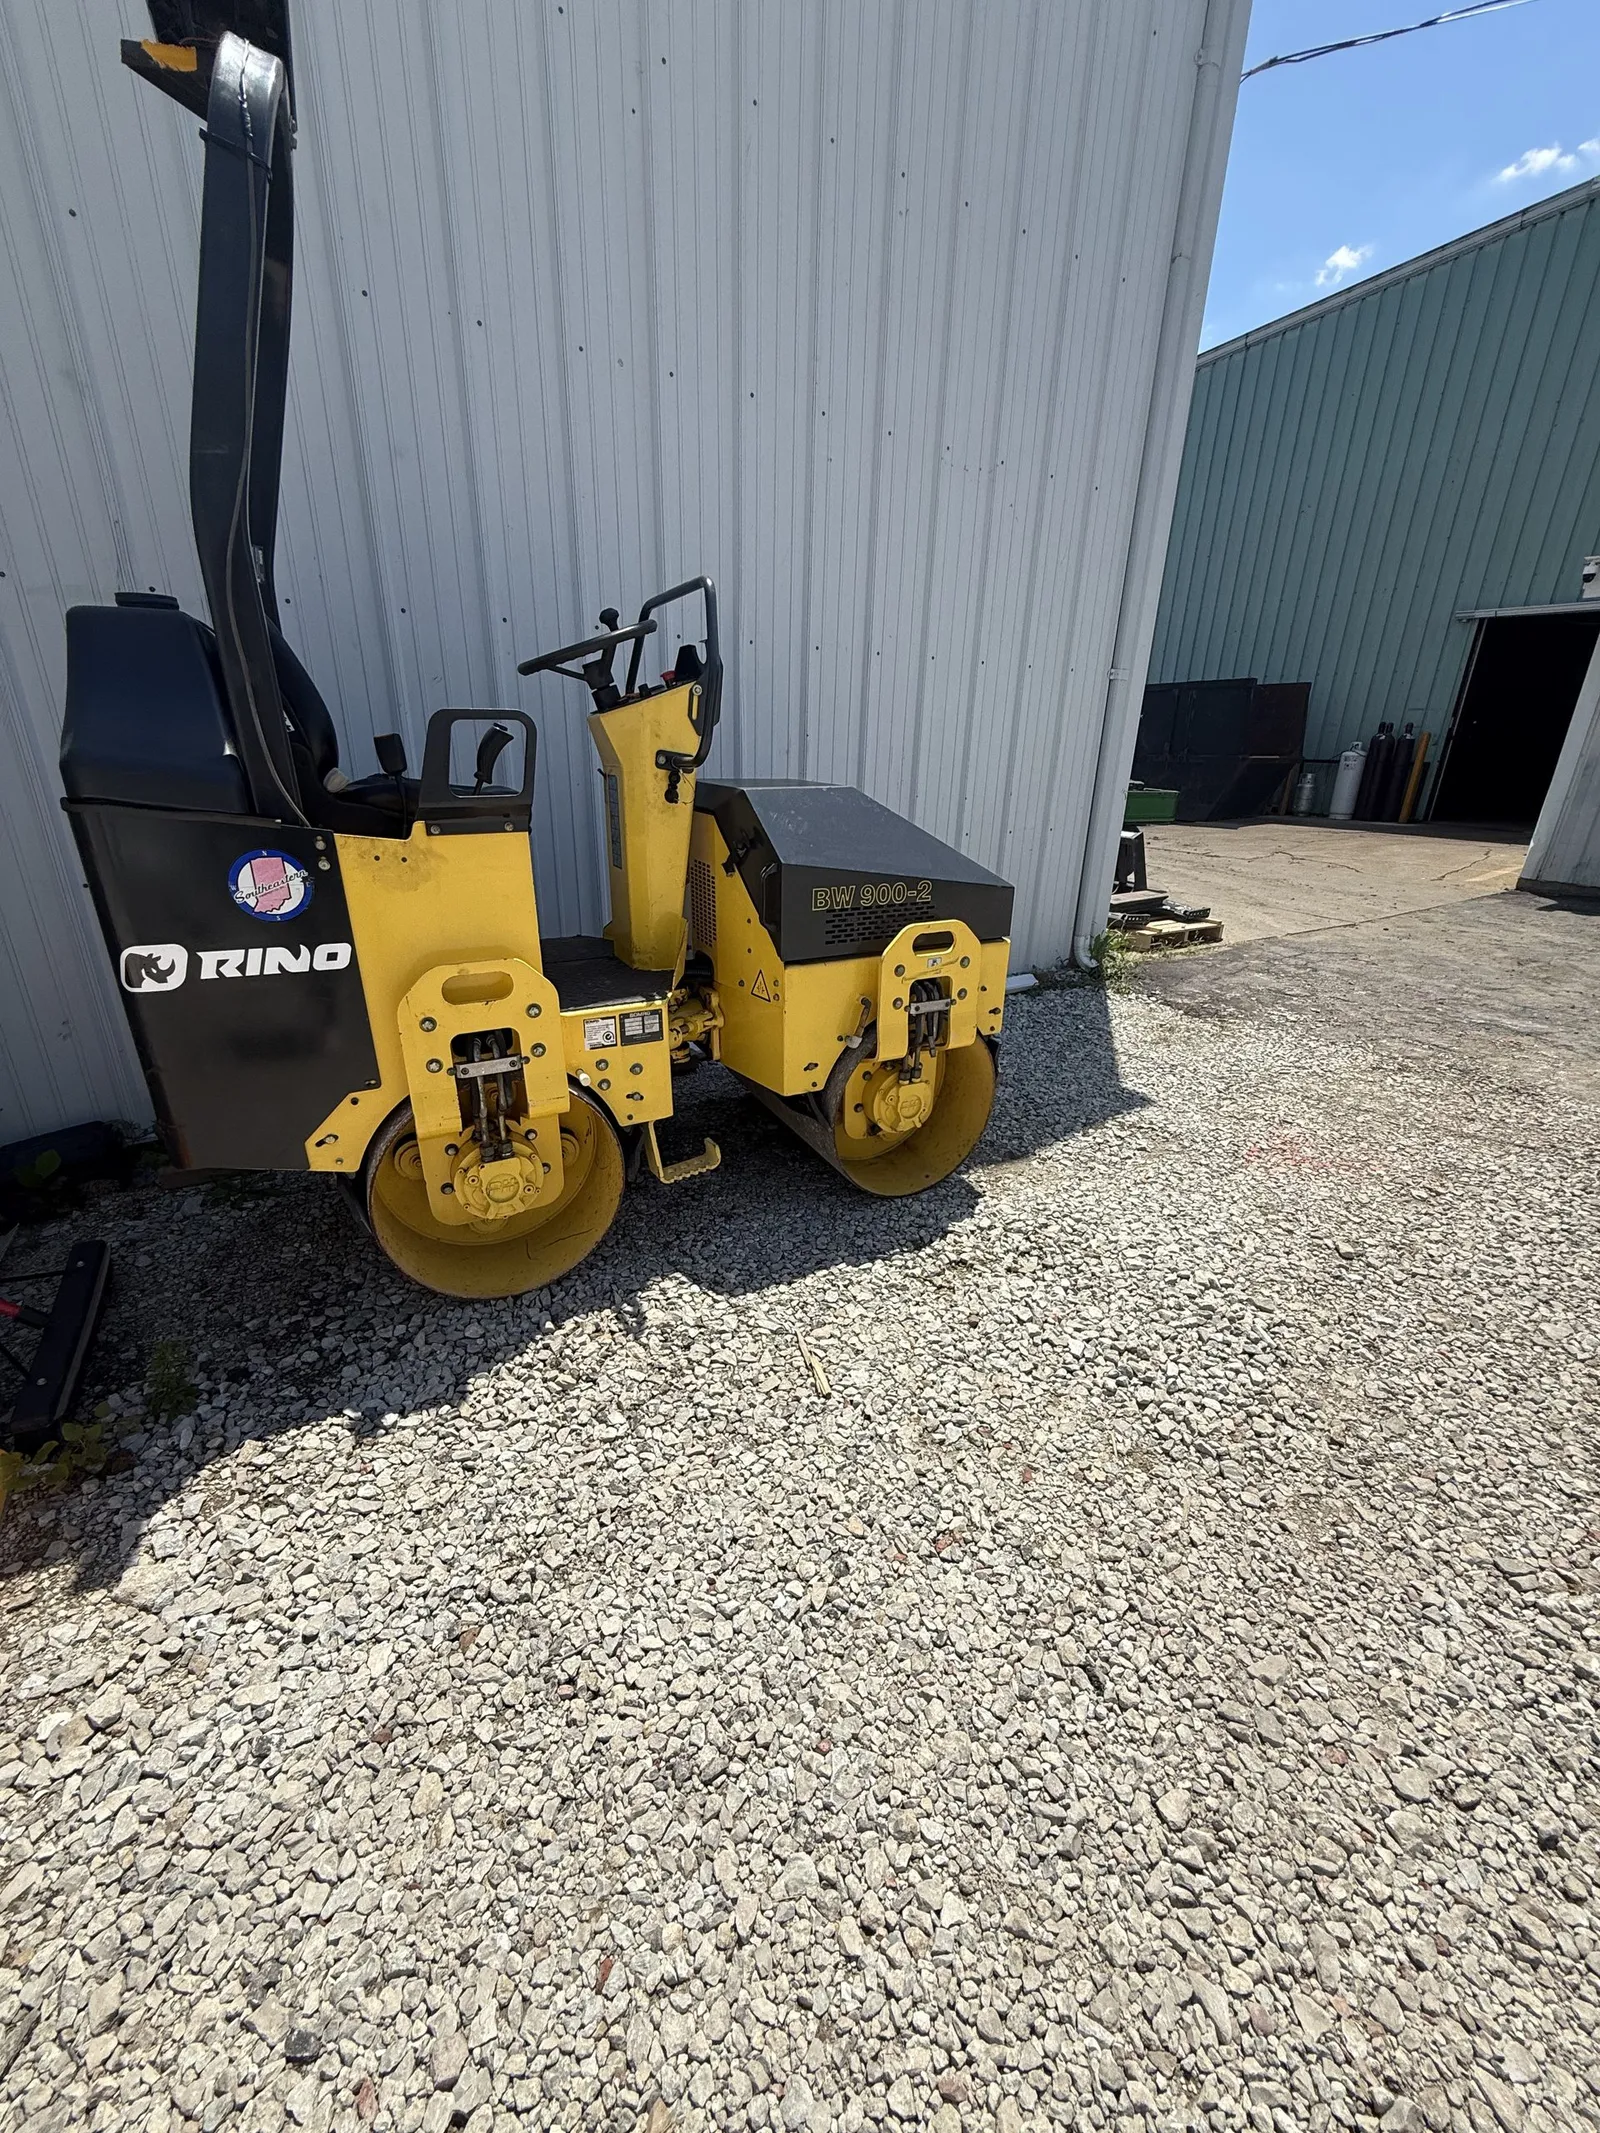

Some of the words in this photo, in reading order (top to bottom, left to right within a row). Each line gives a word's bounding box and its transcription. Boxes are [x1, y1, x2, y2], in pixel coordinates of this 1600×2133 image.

[234, 870, 307, 903] Southeastern
[812, 885, 856, 911] BW
[860, 880, 932, 906] 900-2
[196, 943, 352, 979] RINO
